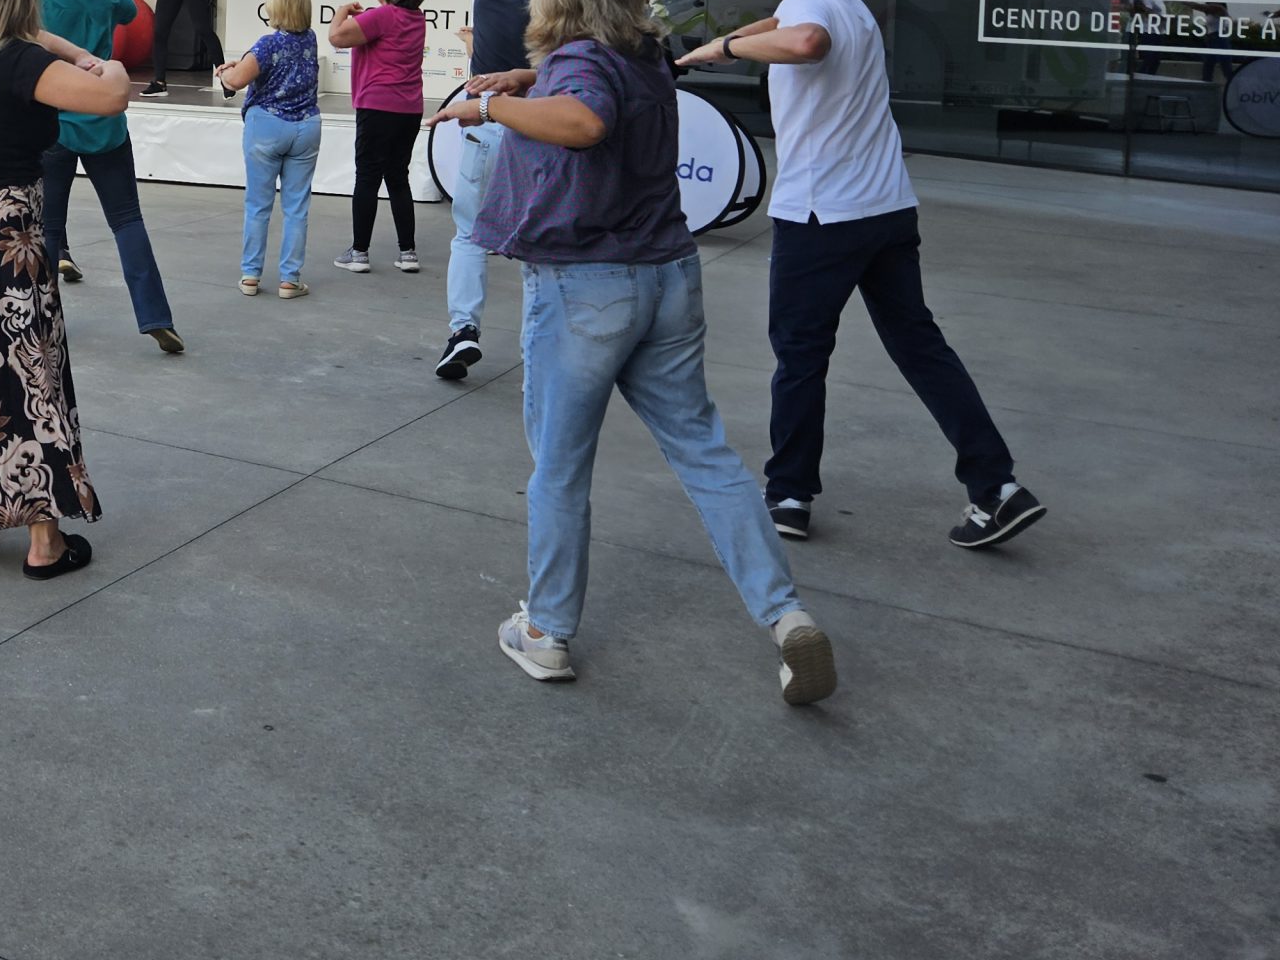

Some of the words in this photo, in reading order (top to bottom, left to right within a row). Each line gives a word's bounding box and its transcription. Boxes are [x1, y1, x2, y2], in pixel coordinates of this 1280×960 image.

[992, 7, 1081, 32] CENTRO
[1091, 11, 1121, 33] DE
[1130, 13, 1208, 37] ARTES
[1218, 16, 1250, 38] DE
[676, 157, 714, 182] da
